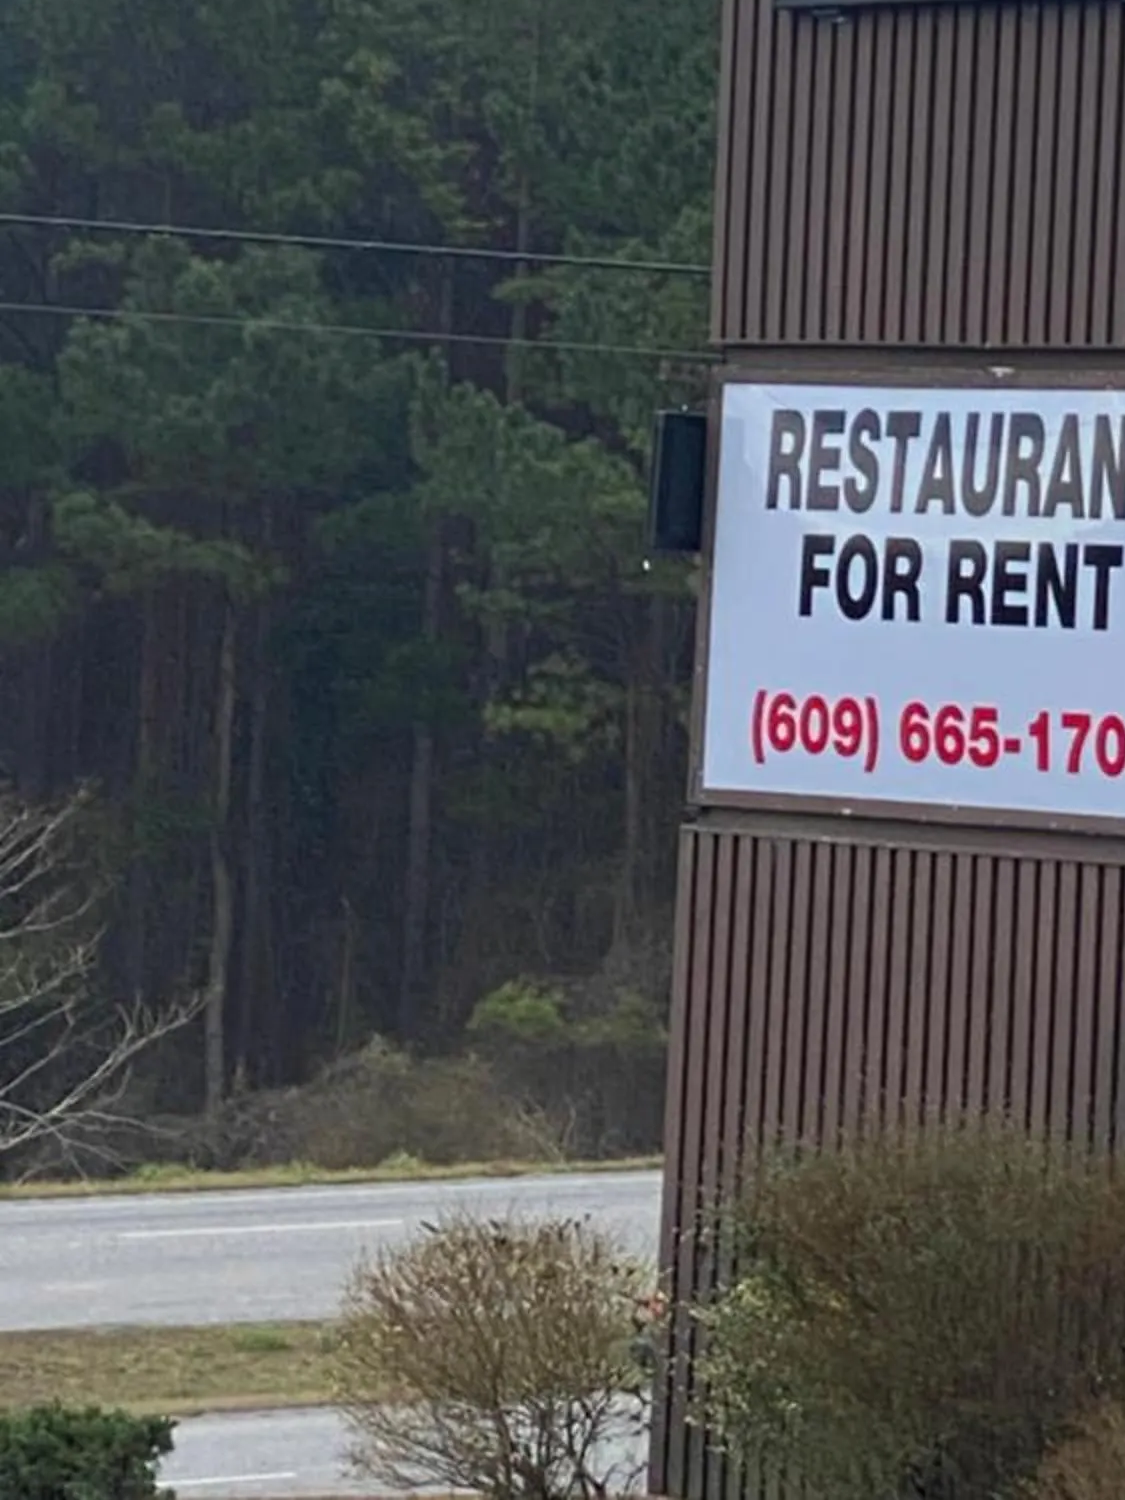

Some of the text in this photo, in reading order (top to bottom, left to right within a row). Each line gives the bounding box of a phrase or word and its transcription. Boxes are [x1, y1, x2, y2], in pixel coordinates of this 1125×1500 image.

[799, 533, 1124, 630] FOR RENT
[751, 689, 879, 773] (609)
